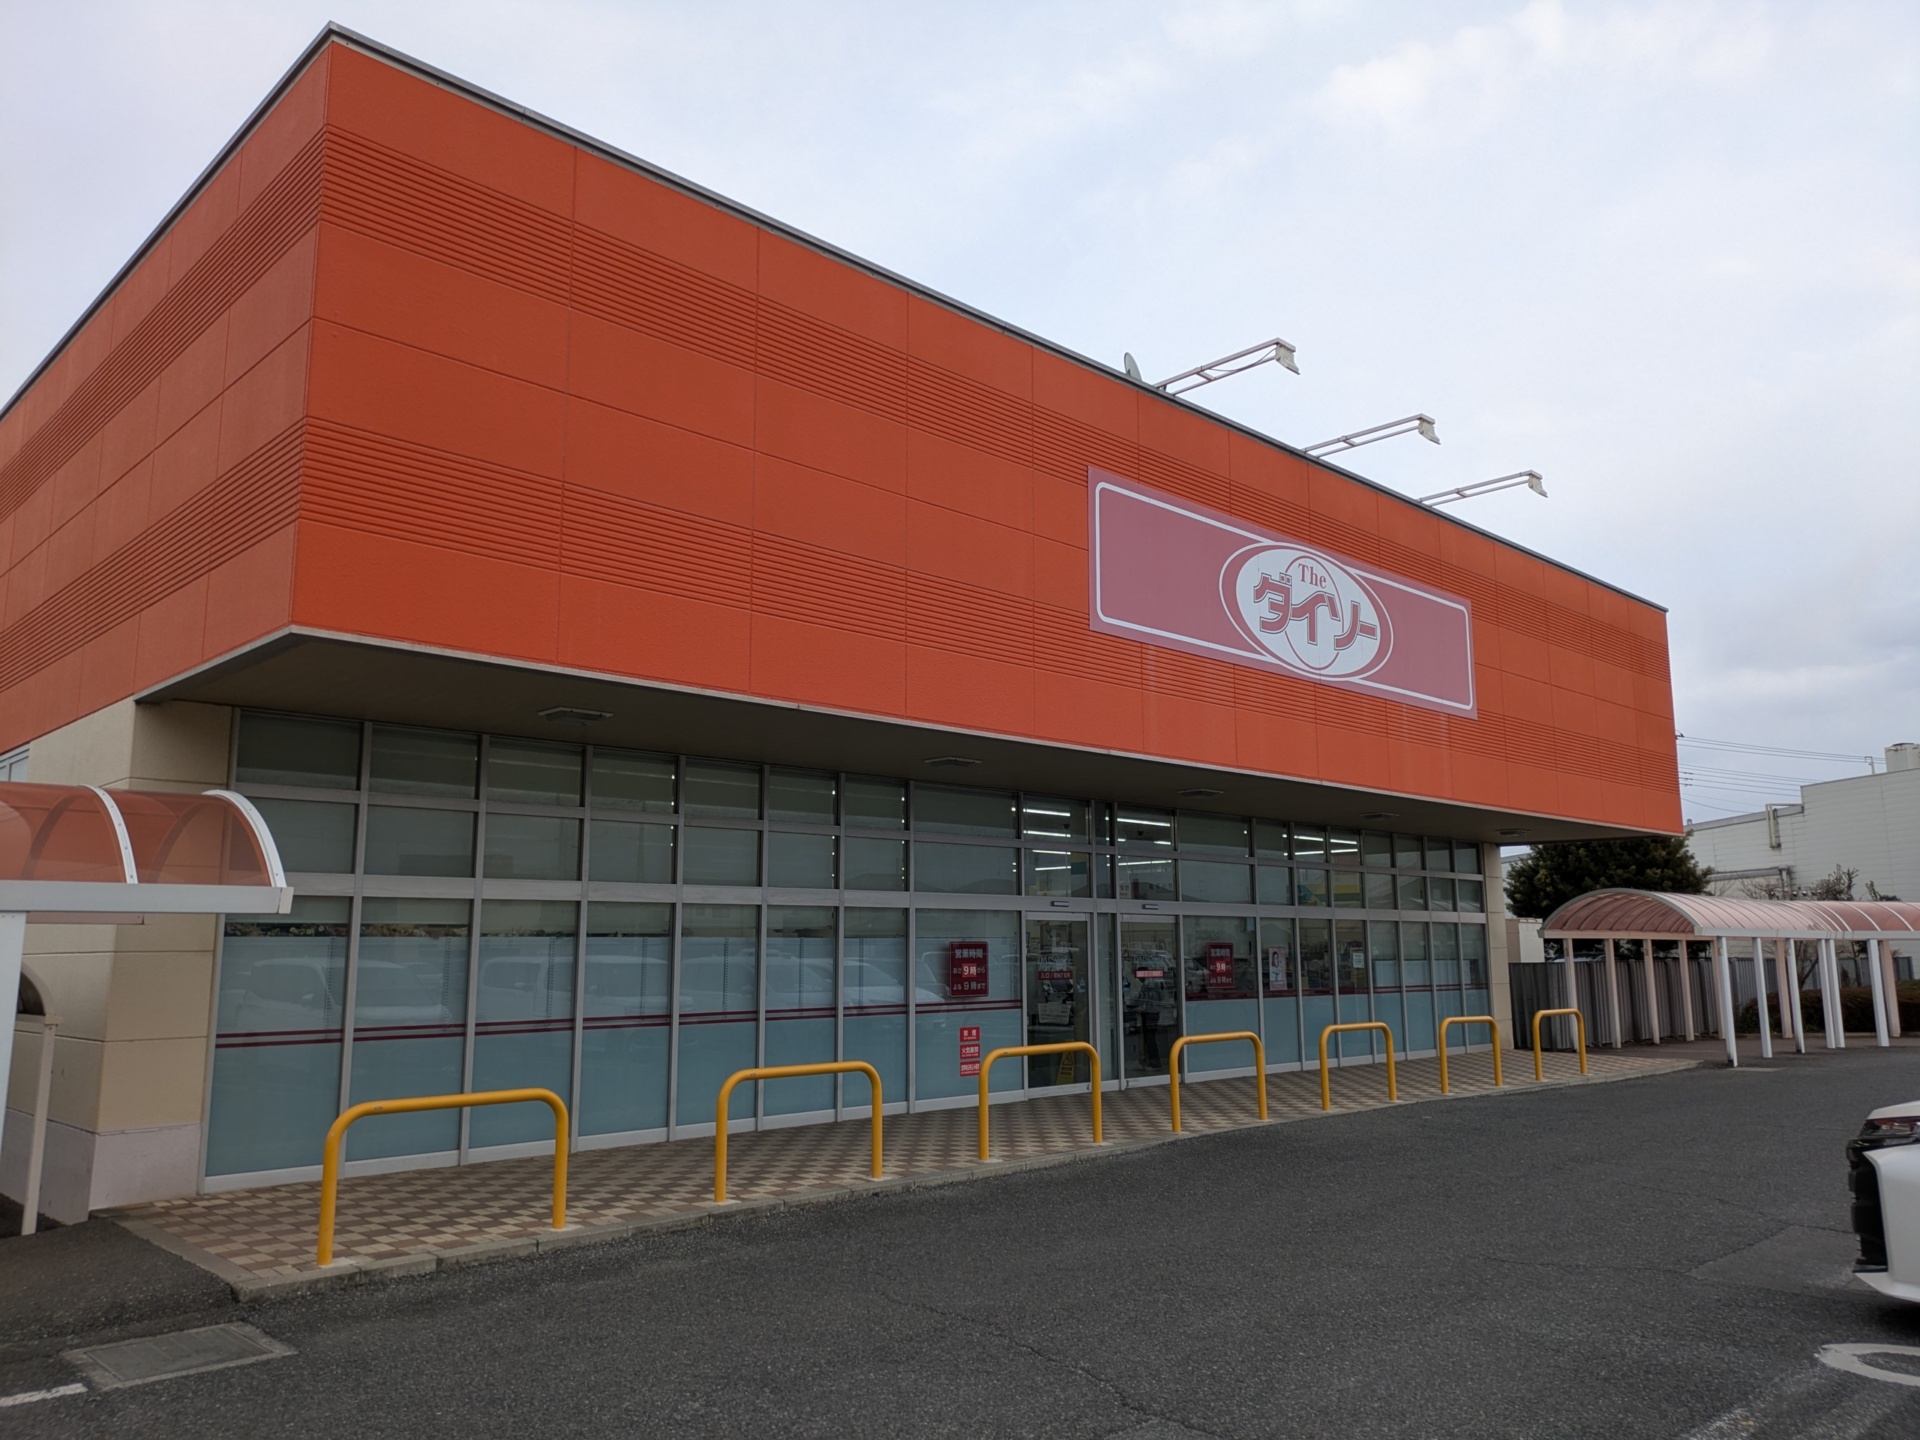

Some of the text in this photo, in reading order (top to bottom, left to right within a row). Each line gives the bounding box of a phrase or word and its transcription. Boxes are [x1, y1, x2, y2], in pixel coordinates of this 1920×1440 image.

[1298, 563, 1327, 589] The
[1253, 572, 1377, 651] ダイソー
[954, 948, 983, 959] 営業時間
